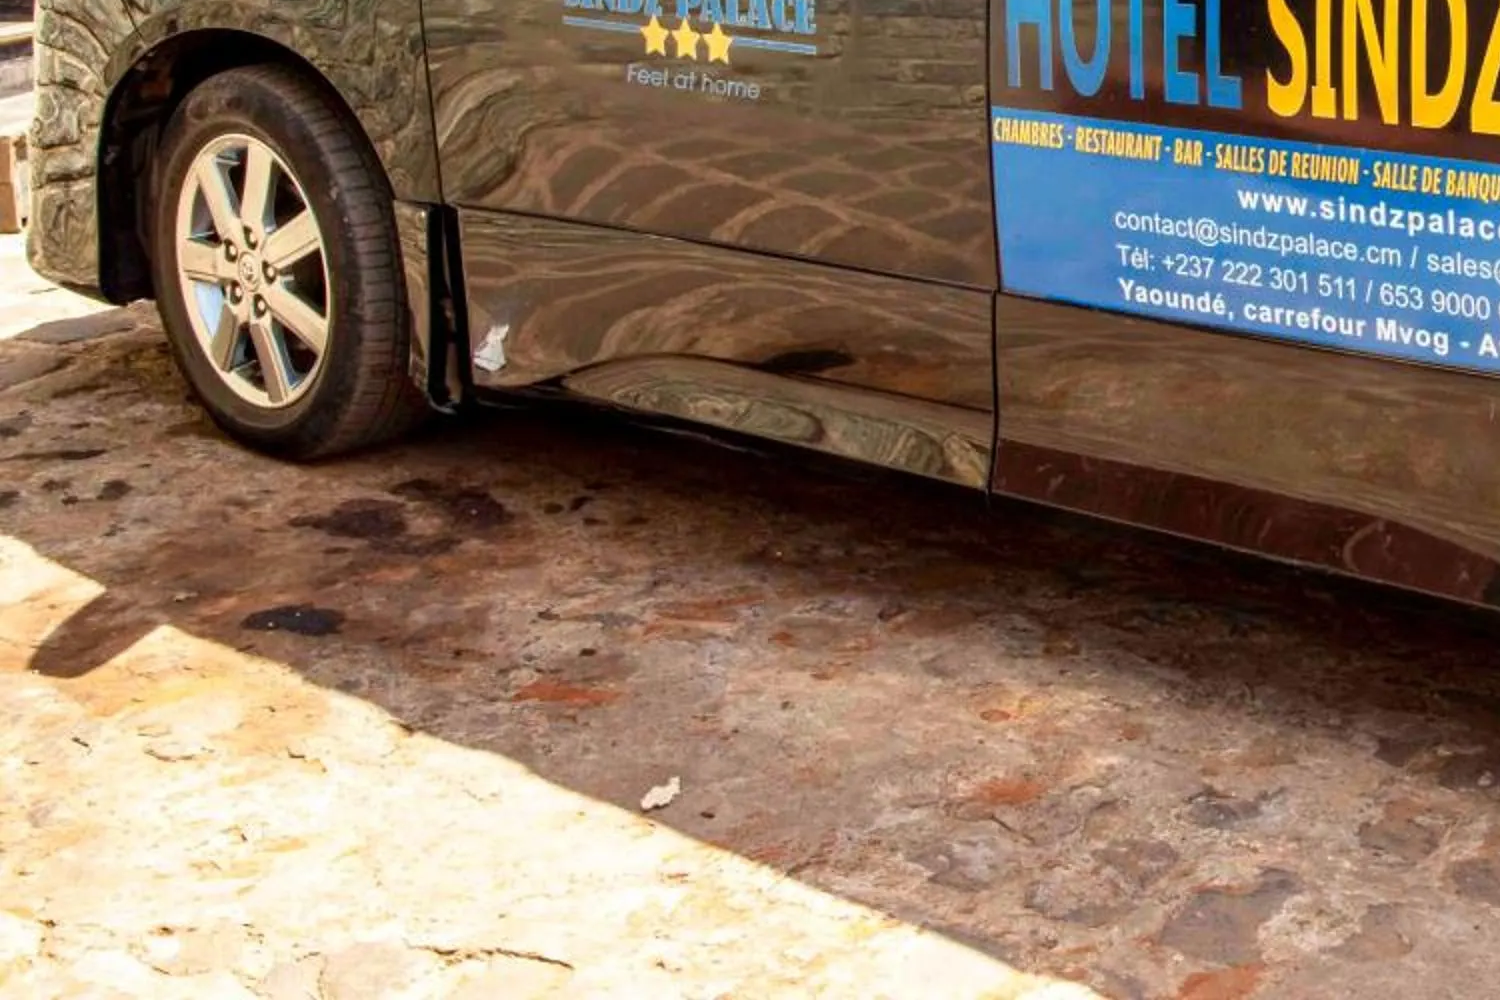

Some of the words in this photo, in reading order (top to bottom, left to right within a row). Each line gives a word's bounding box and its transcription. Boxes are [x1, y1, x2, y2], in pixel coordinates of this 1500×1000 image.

[627, 63, 669, 87] Feel
[674, 71, 695, 91] at
[701, 73, 761, 99] home
[993, 118, 1064, 149] CHAMBRES
[1075, 125, 1163, 161] RESTAURANT
[1173, 137, 1203, 166] BAR
[1215, 143, 1265, 174] SALLES
[1268, 150, 1287, 177] DE
[1291, 152, 1360, 185] REUNION
[1372, 161, 1417, 192] SALLE
[1421, 166, 1443, 195] DE
[1115, 210, 1401, 267] contact@sindzpalace.cm
[1119, 277, 1235, 321] Yaoundé,
[1244, 302, 1366, 338] carrefour
[1375, 317, 1449, 356] Mvog
[1162, 252, 1214, 280] +237
[1222, 260, 1262, 287] 222
[1270, 266, 1308, 294] 301
[1318, 273, 1356, 300] 511
[1379, 282, 1423, 310] 653
[1431, 289, 1490, 320] 9000
